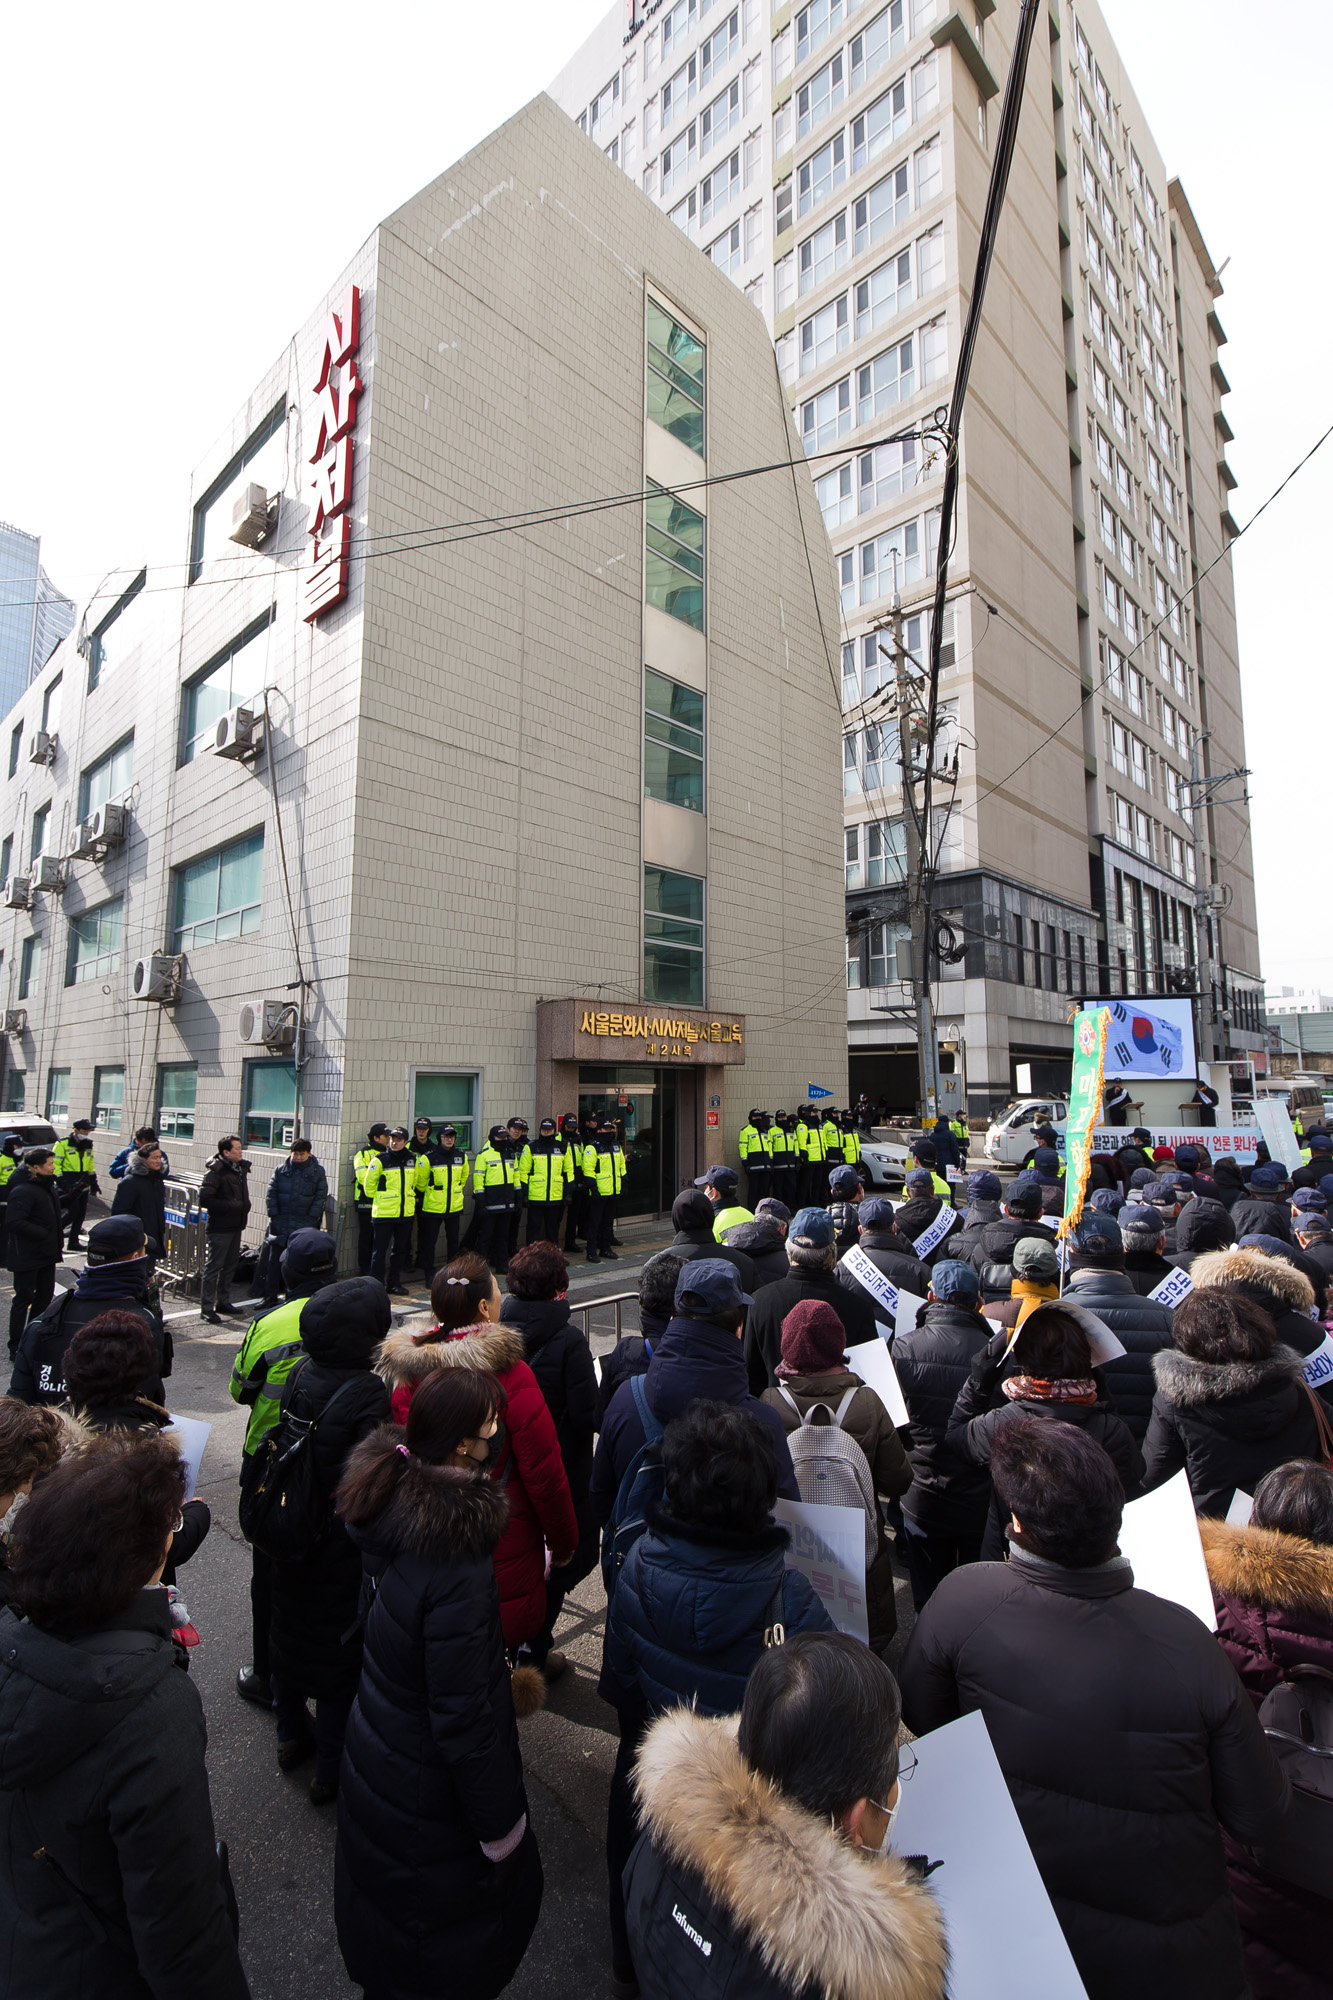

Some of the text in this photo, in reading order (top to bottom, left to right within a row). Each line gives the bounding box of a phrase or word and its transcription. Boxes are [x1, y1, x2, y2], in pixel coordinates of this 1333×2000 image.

[303, 285, 362, 623] 시사저널
[1213, 1136, 1231, 1152] 언론
[1234, 1136, 1257, 1152] 맞나?
[671, 1903, 703, 1948] Lafuma
